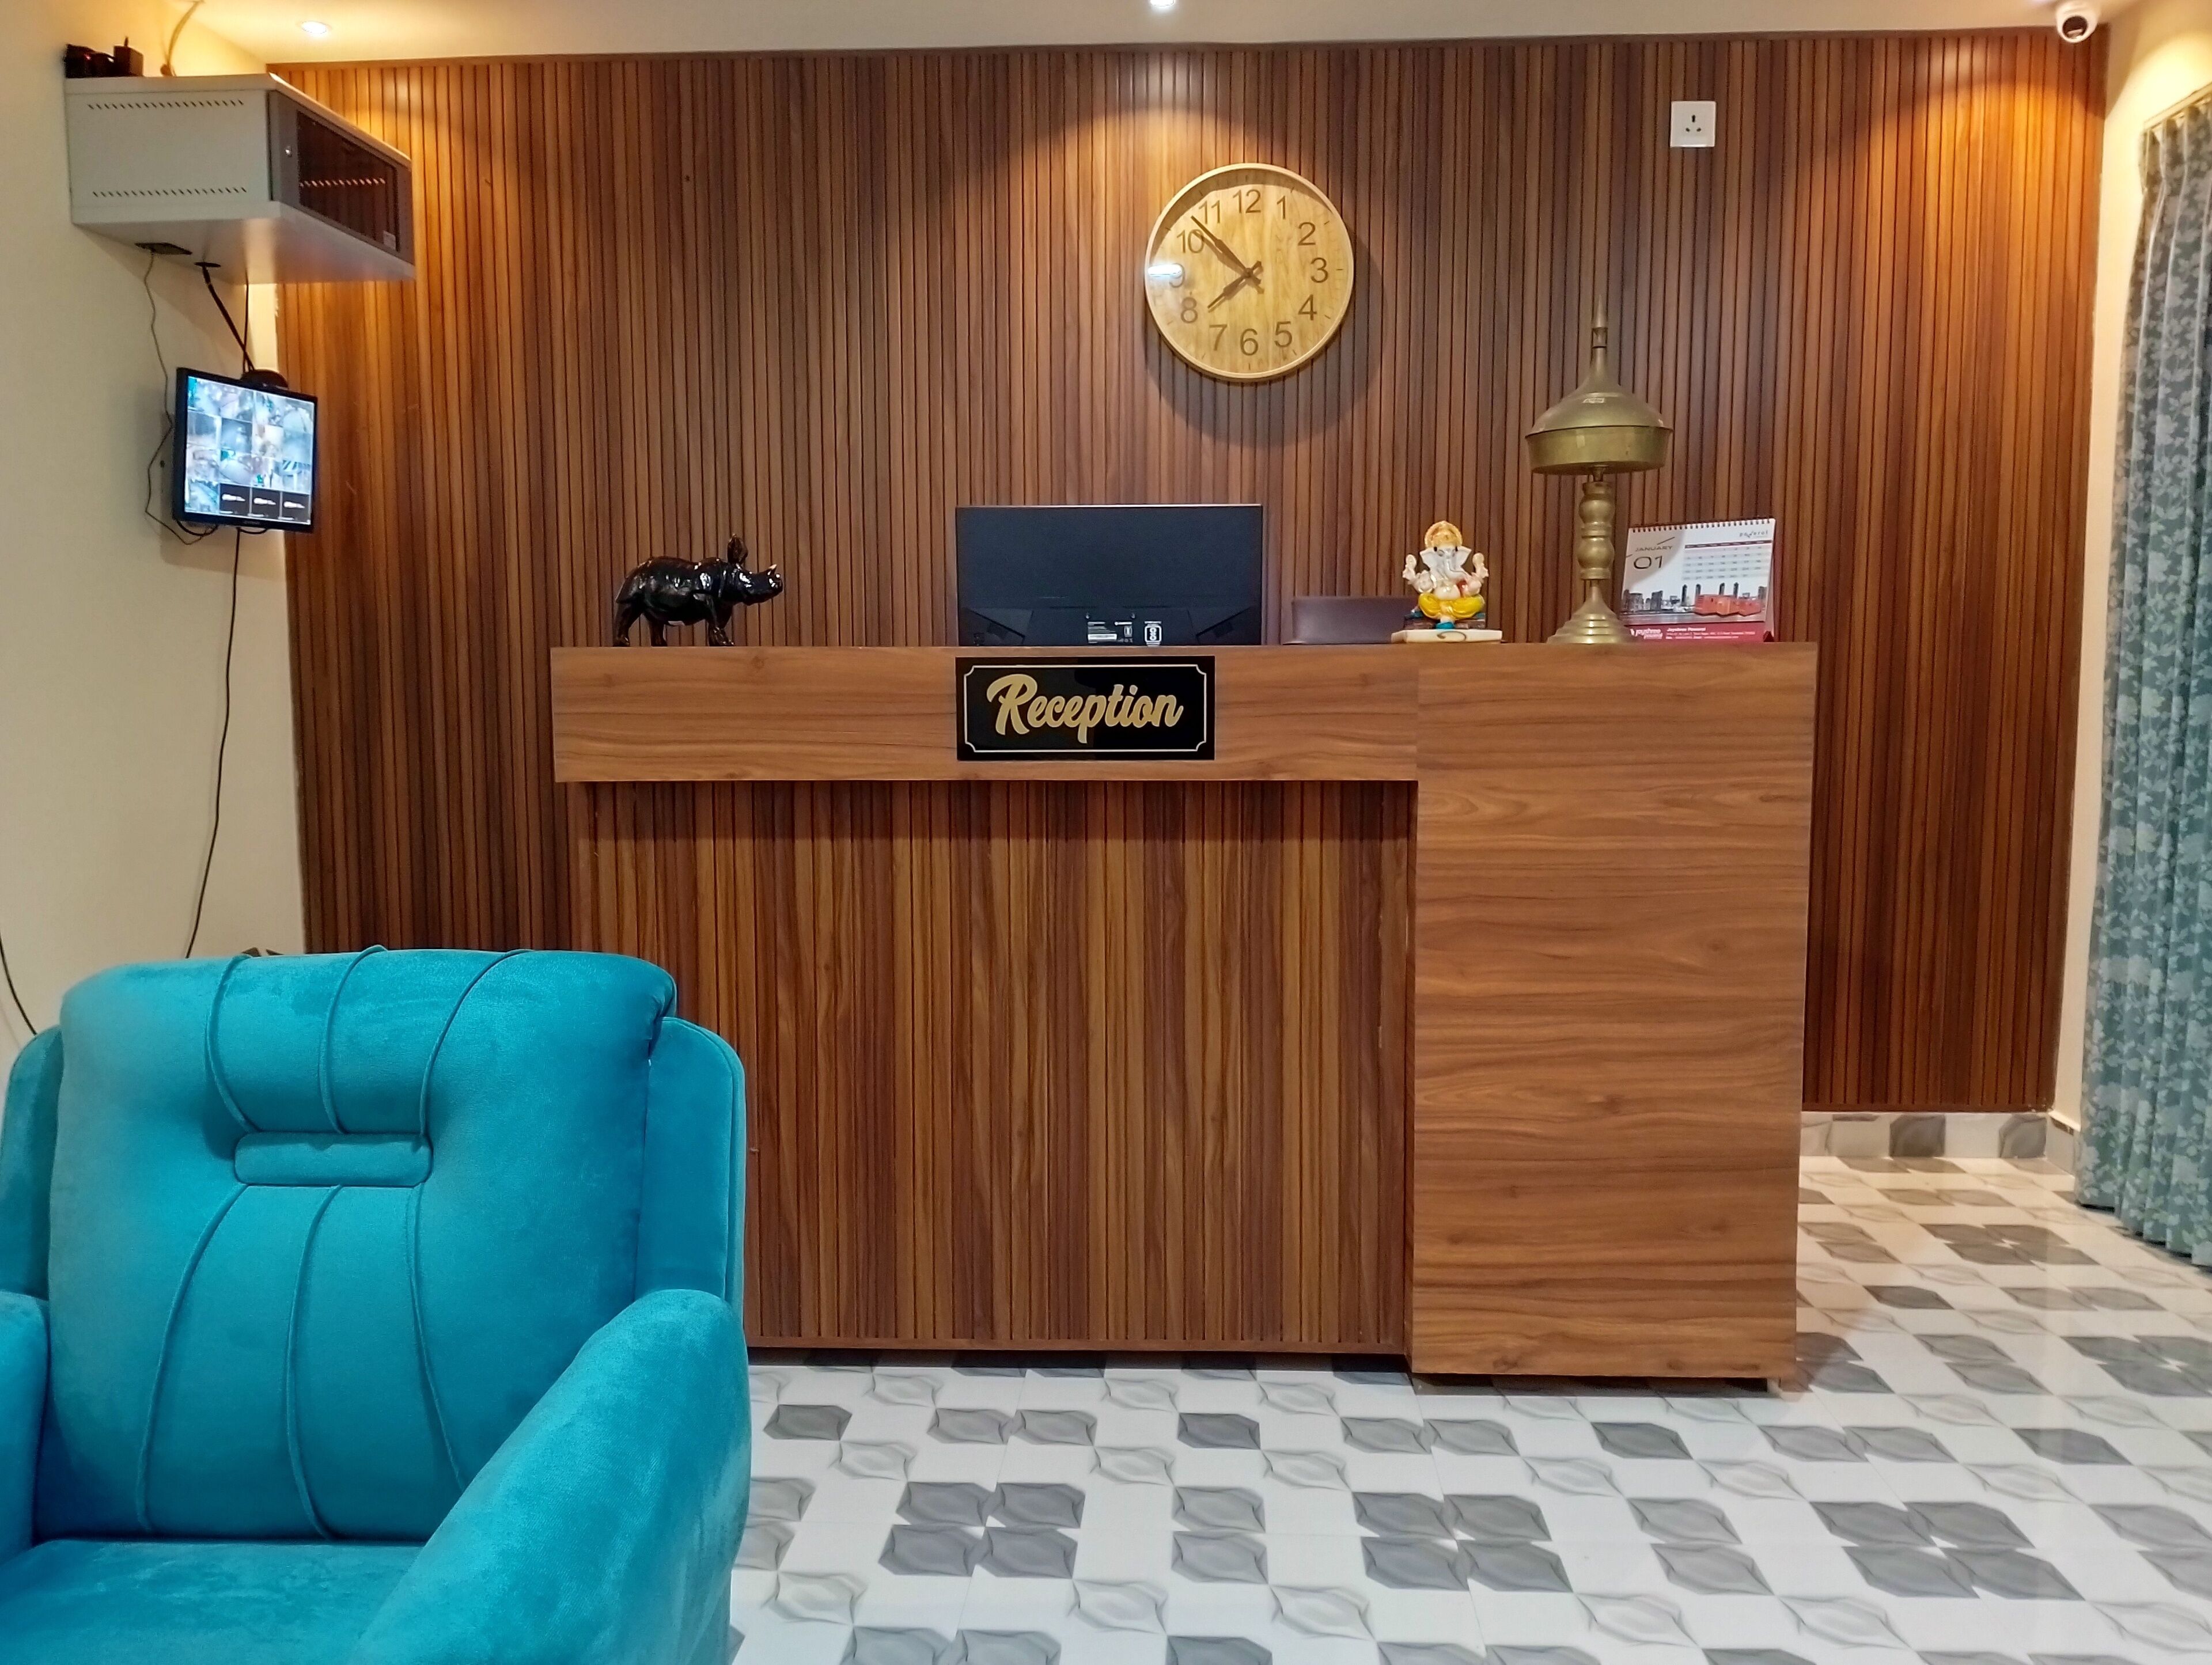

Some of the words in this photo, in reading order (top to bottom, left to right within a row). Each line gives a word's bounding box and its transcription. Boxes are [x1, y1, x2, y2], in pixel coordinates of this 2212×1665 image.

[1198, 200, 1221, 225] 11
[1233, 189, 1261, 214] 12
[1277, 195, 1286, 220] 1
[1176, 229, 1205, 254] 10
[1297, 222, 1316, 246] 2
[1310, 257, 1329, 283] 3
[1180, 297, 1198, 324] 8
[1298, 294, 1317, 321] 4
[1210, 324, 1228, 351] 7
[1240, 328, 1259, 355] 6
[1274, 321, 1293, 347] 5
[1634, 555, 1662, 569] 01
[987, 674, 1184, 744] Reception
